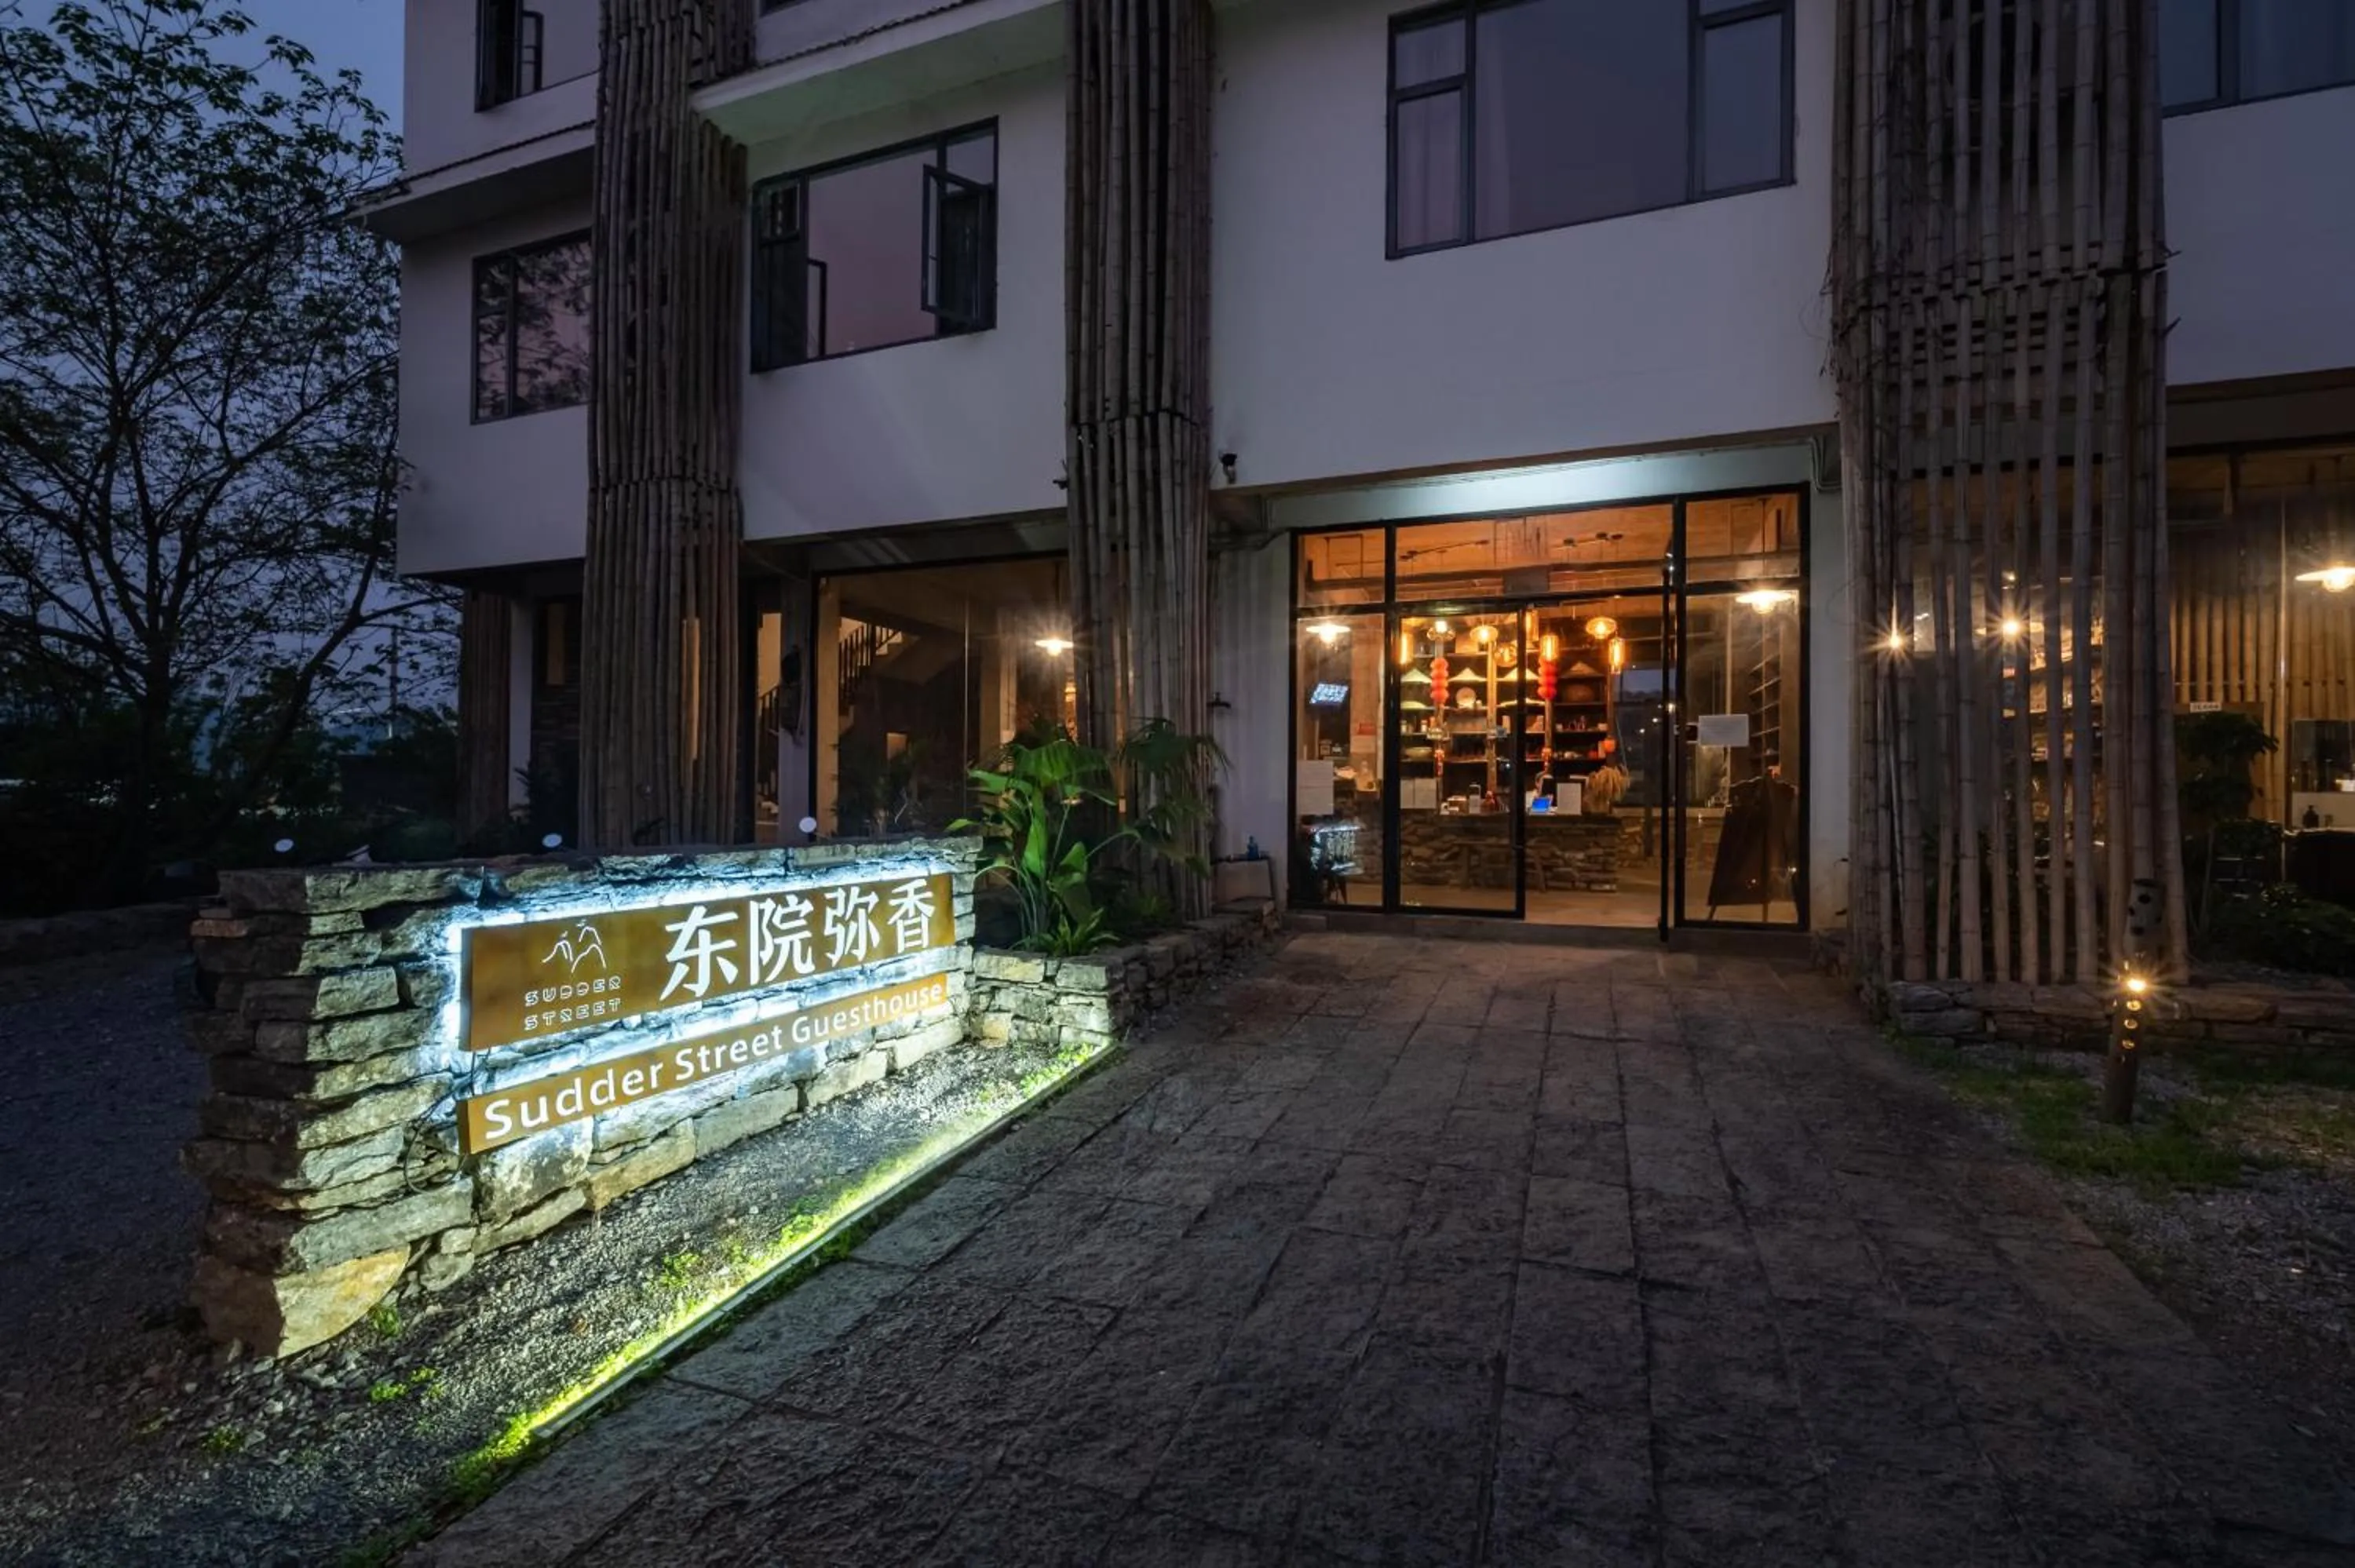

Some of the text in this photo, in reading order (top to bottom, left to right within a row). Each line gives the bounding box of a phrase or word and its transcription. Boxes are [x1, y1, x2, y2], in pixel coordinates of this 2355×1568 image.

[659, 878, 936, 1001] 东院弥香
[524, 975, 621, 1007] SUDDER
[524, 997, 621, 1030] STREET
[484, 983, 943, 1139] Sudder Street Guesthouse
